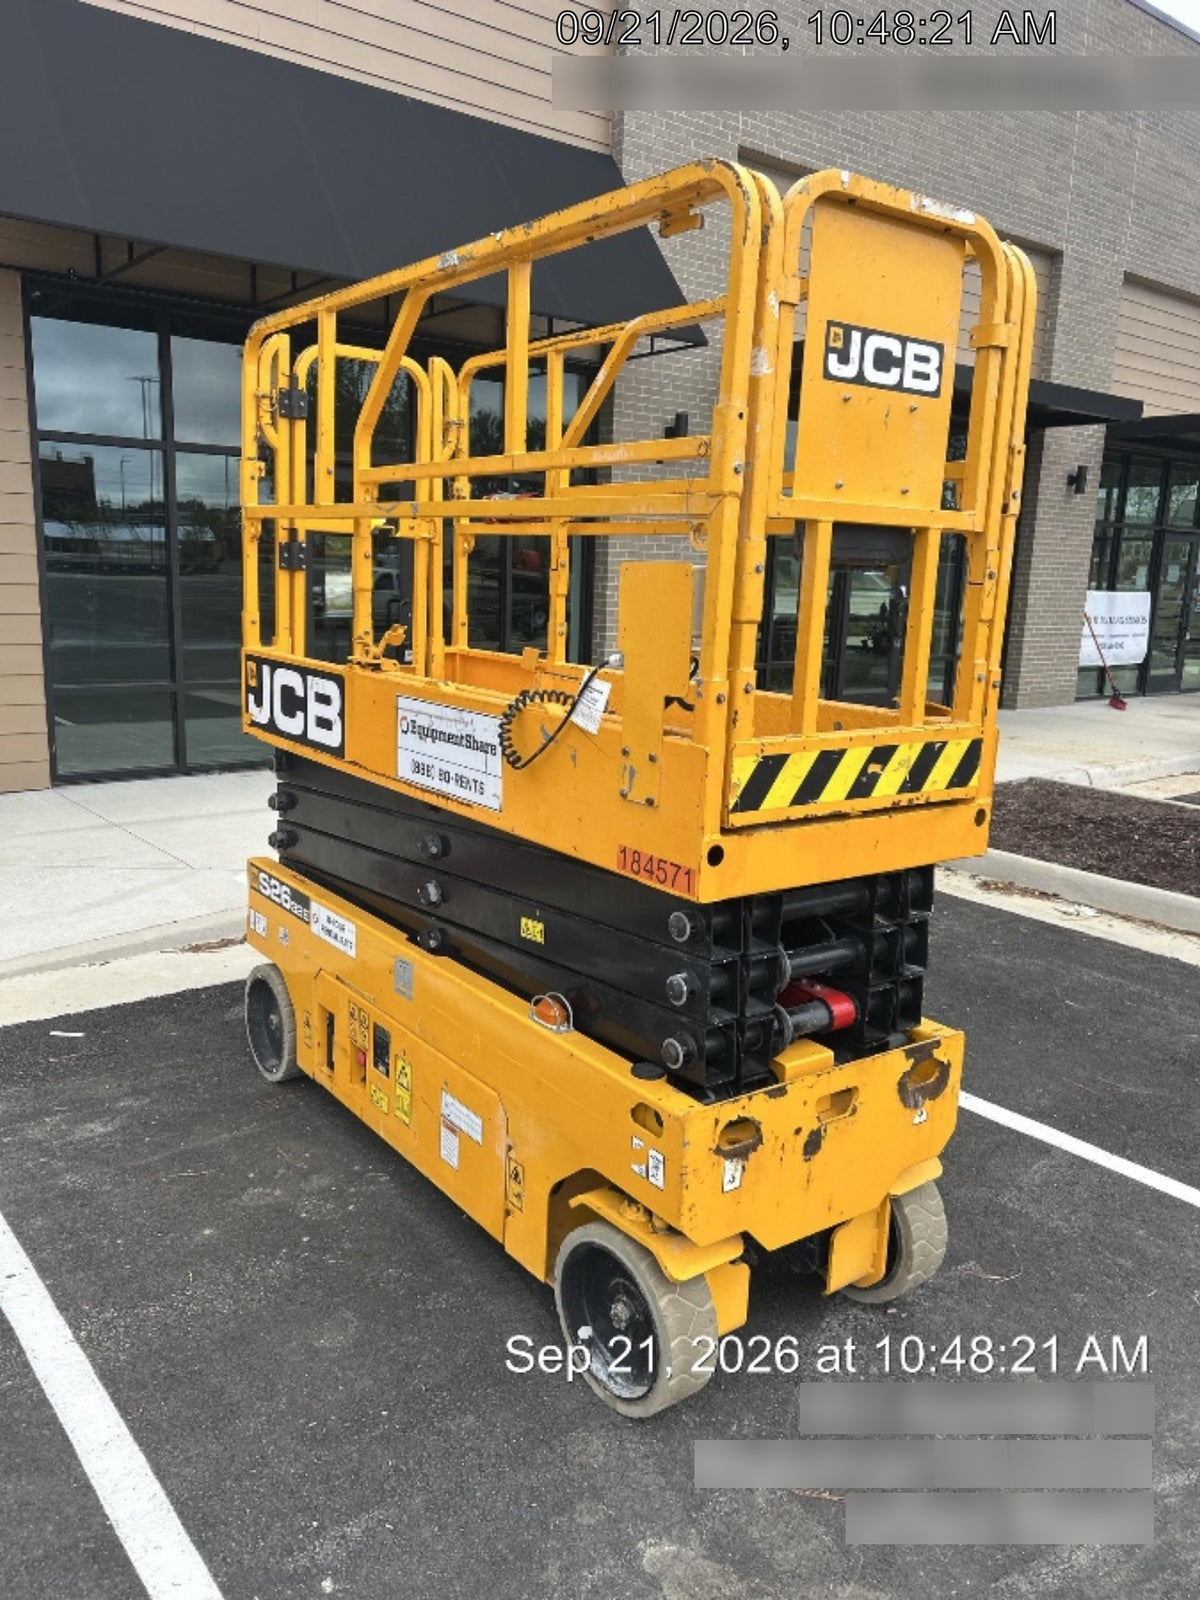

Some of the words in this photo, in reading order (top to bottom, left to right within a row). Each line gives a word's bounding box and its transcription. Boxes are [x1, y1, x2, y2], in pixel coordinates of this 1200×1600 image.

[827, 330, 940, 392] JCB
[247, 664, 342, 748] JCB
[410, 719, 497, 756] EquipmentShare
[619, 846, 693, 893] 184571
